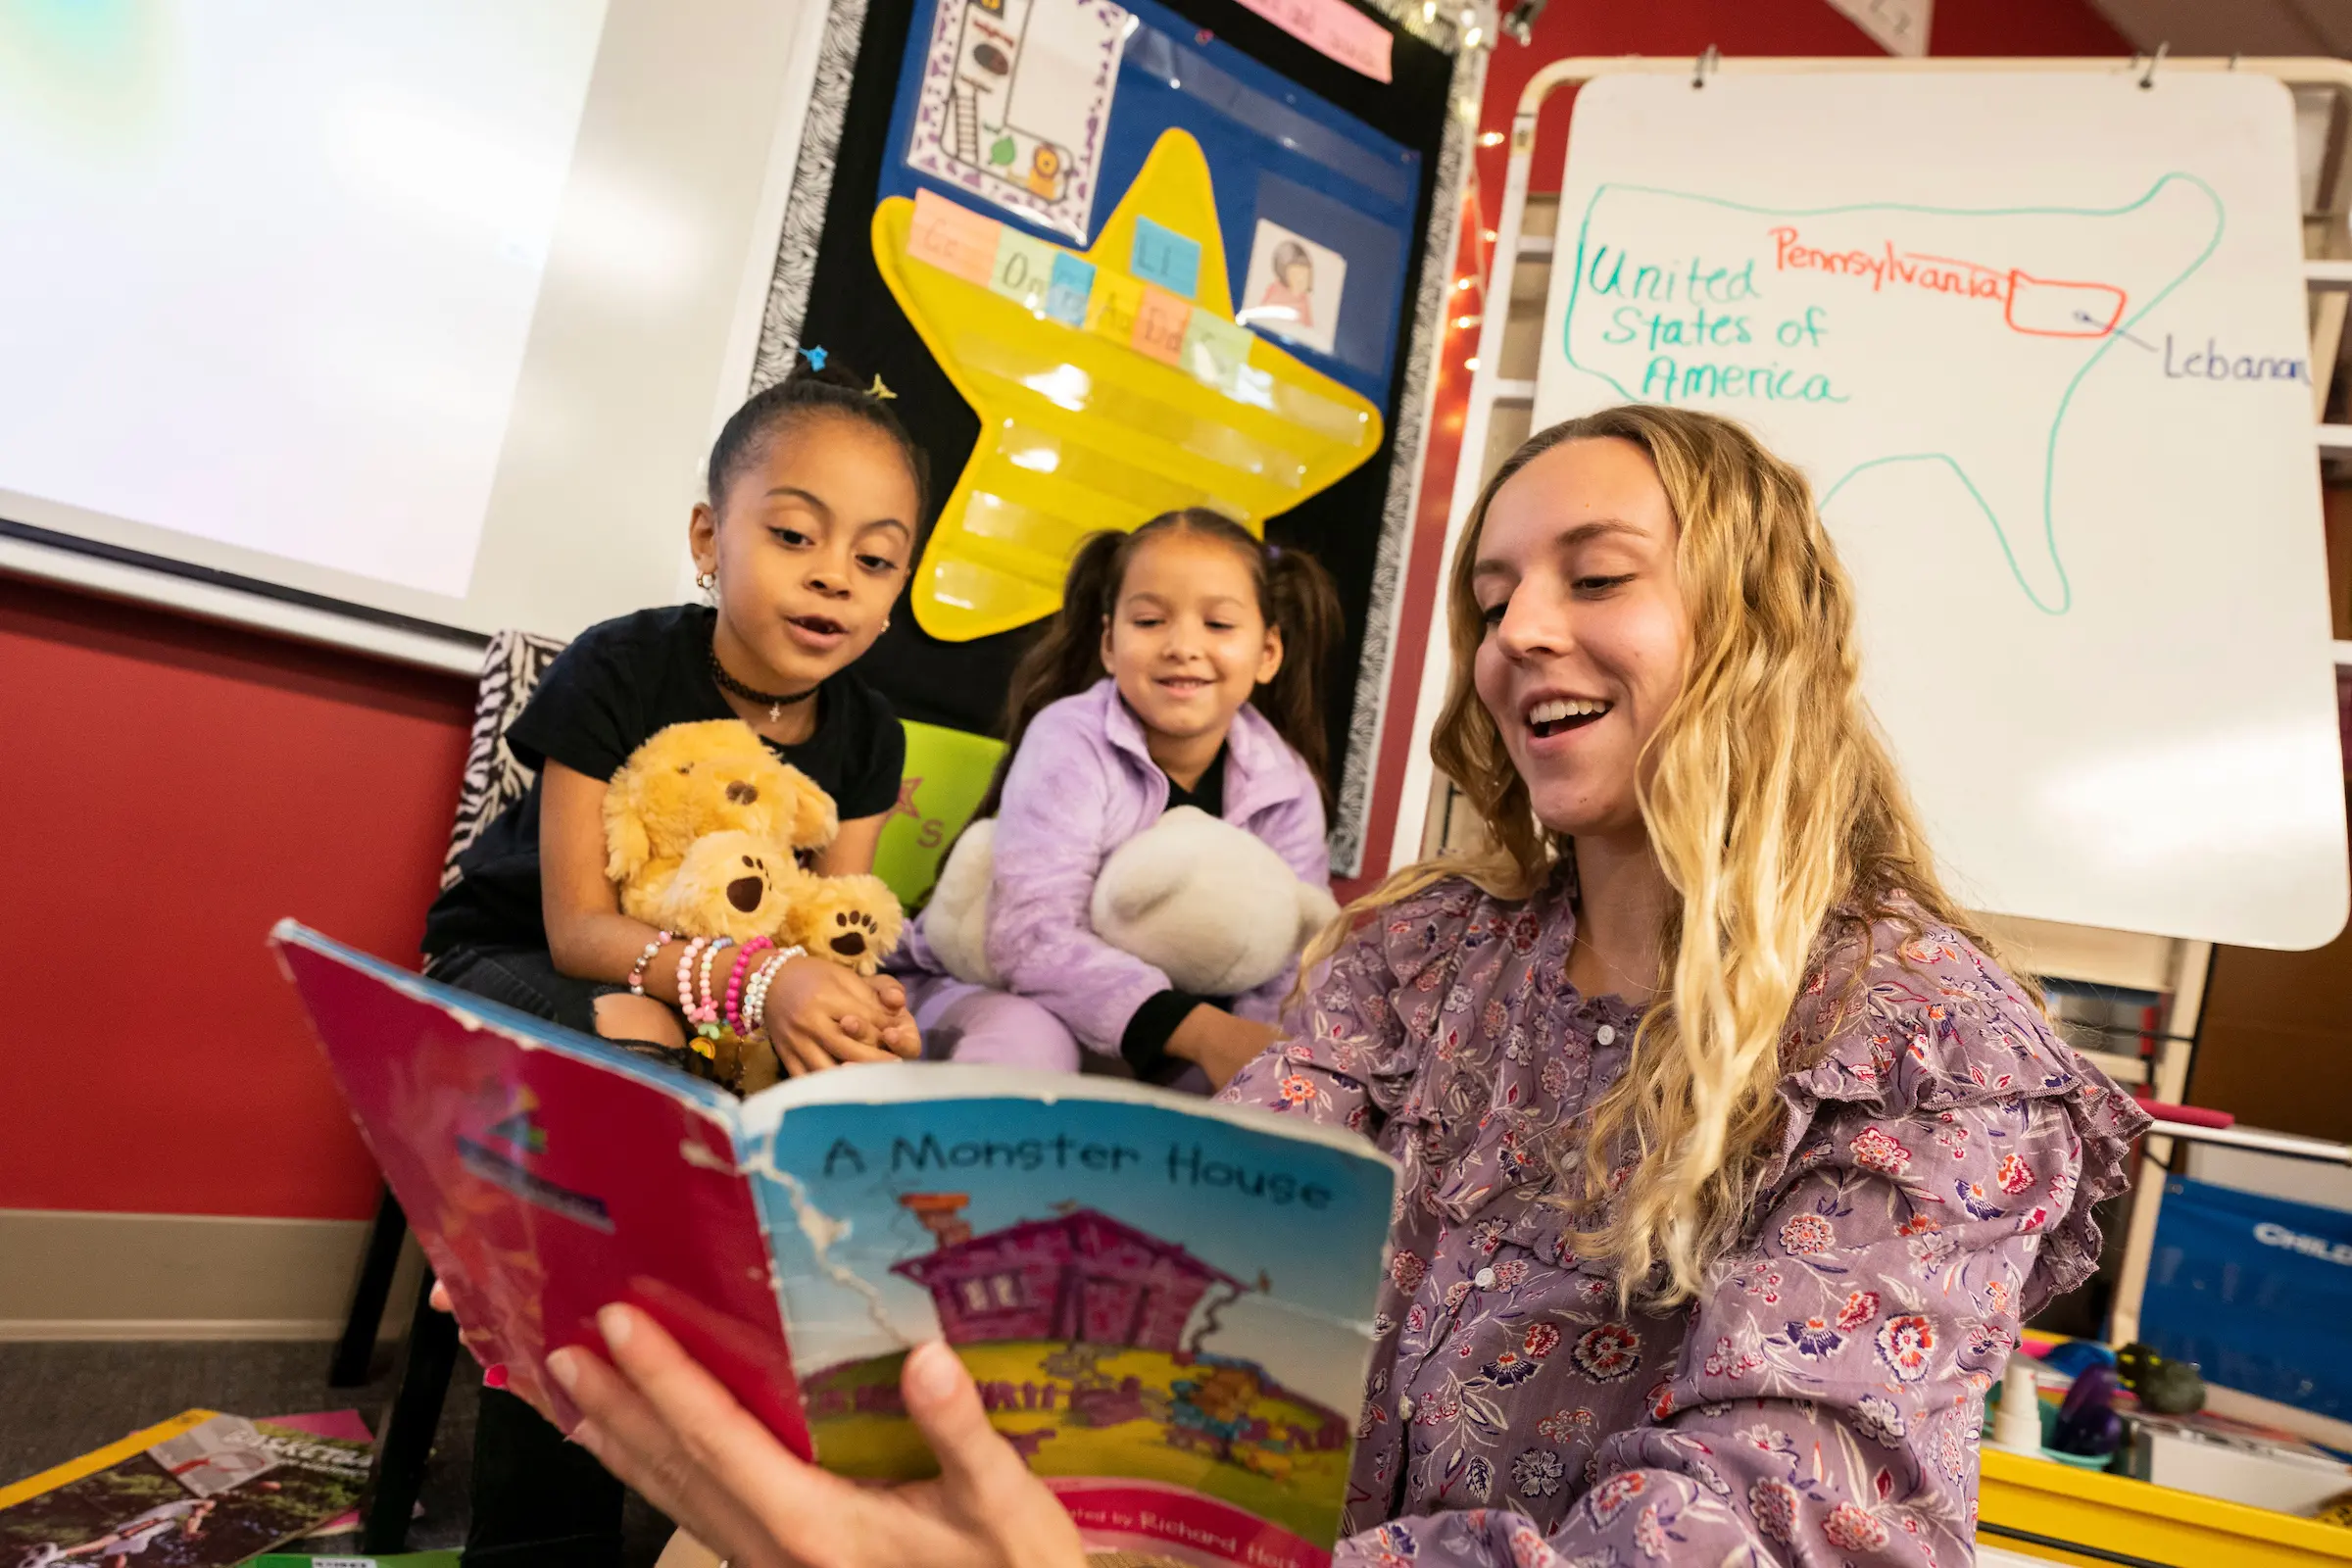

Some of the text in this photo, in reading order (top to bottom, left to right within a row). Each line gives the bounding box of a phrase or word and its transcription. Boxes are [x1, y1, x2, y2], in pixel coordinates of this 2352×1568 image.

[1589, 244, 1762, 307] United
[1767, 225, 2006, 302] Pennsylvania
[1601, 305, 1829, 351] States of
[1641, 355, 1850, 404] America
[822, 1132, 1335, 1211] A Monster House
[1111, 1510, 1133, 1529] by
[1140, 1510, 1238, 1553] Richard
